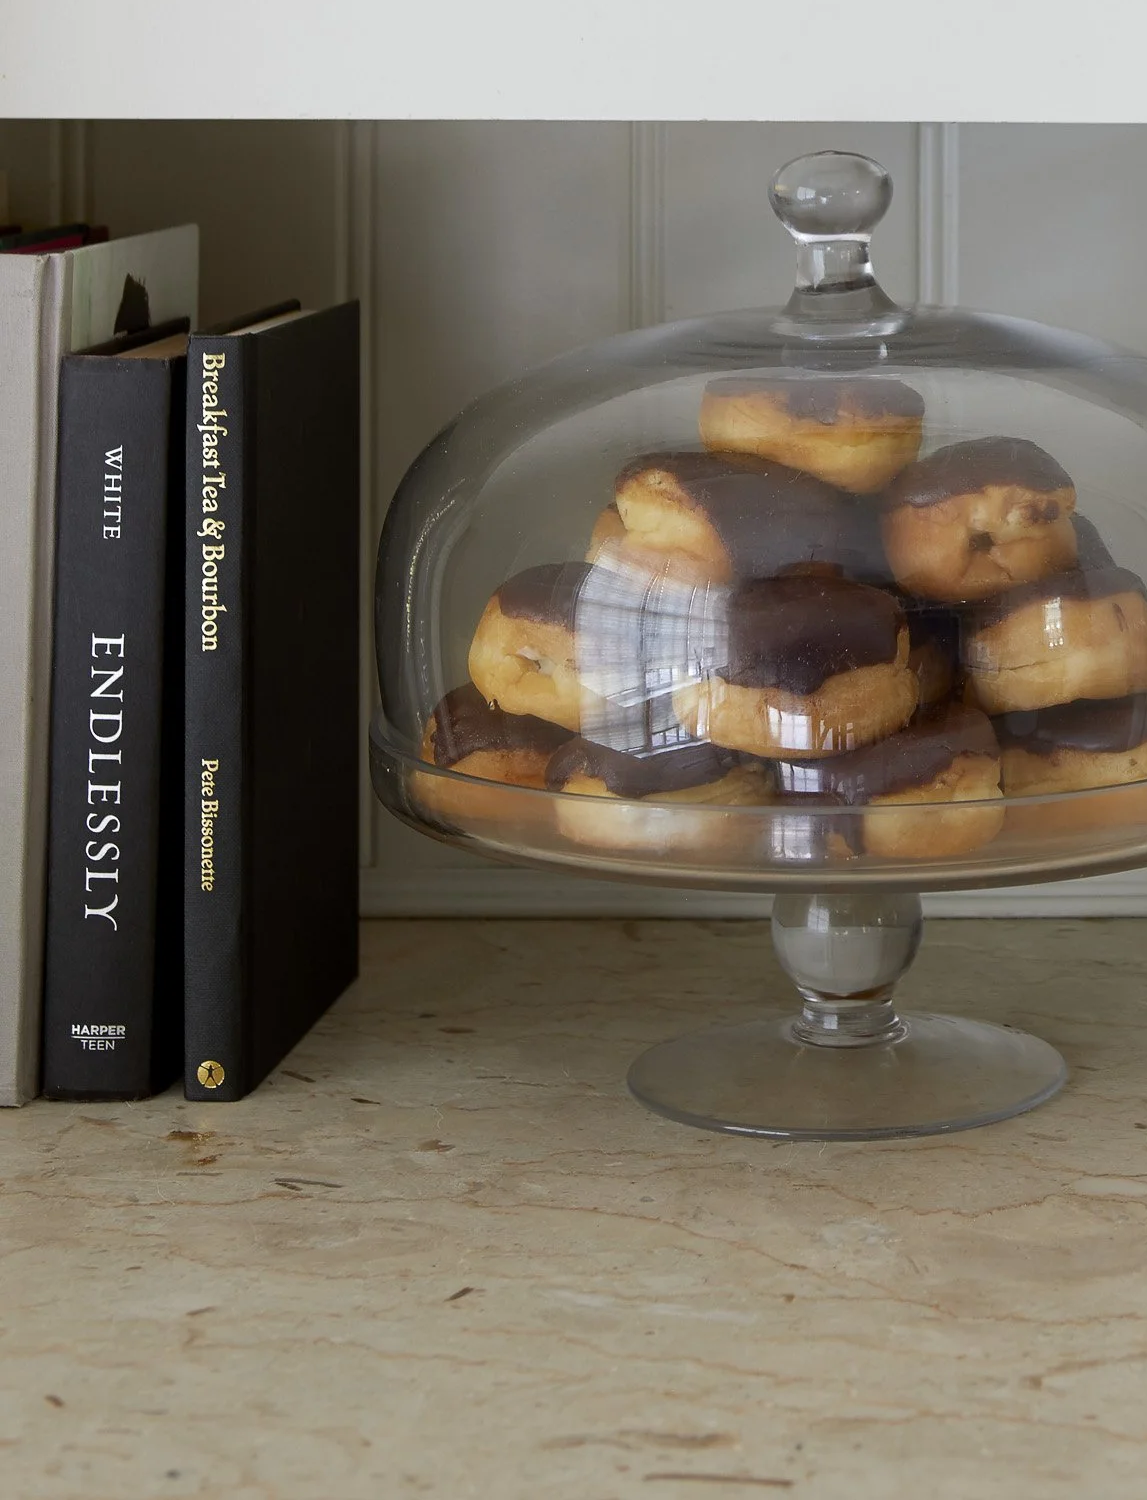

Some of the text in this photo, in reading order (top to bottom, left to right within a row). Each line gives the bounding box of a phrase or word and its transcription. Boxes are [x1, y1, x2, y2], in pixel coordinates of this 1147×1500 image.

[102, 444, 123, 540] WHITE
[196, 351, 228, 652] Breakfast Tea & Bourbon
[84, 632, 125, 932] ENDLESSLY
[200, 758, 219, 892] Pete Bissonette
[71, 1024, 126, 1035] HARPER
[80, 1039, 115, 1051] TEEN
